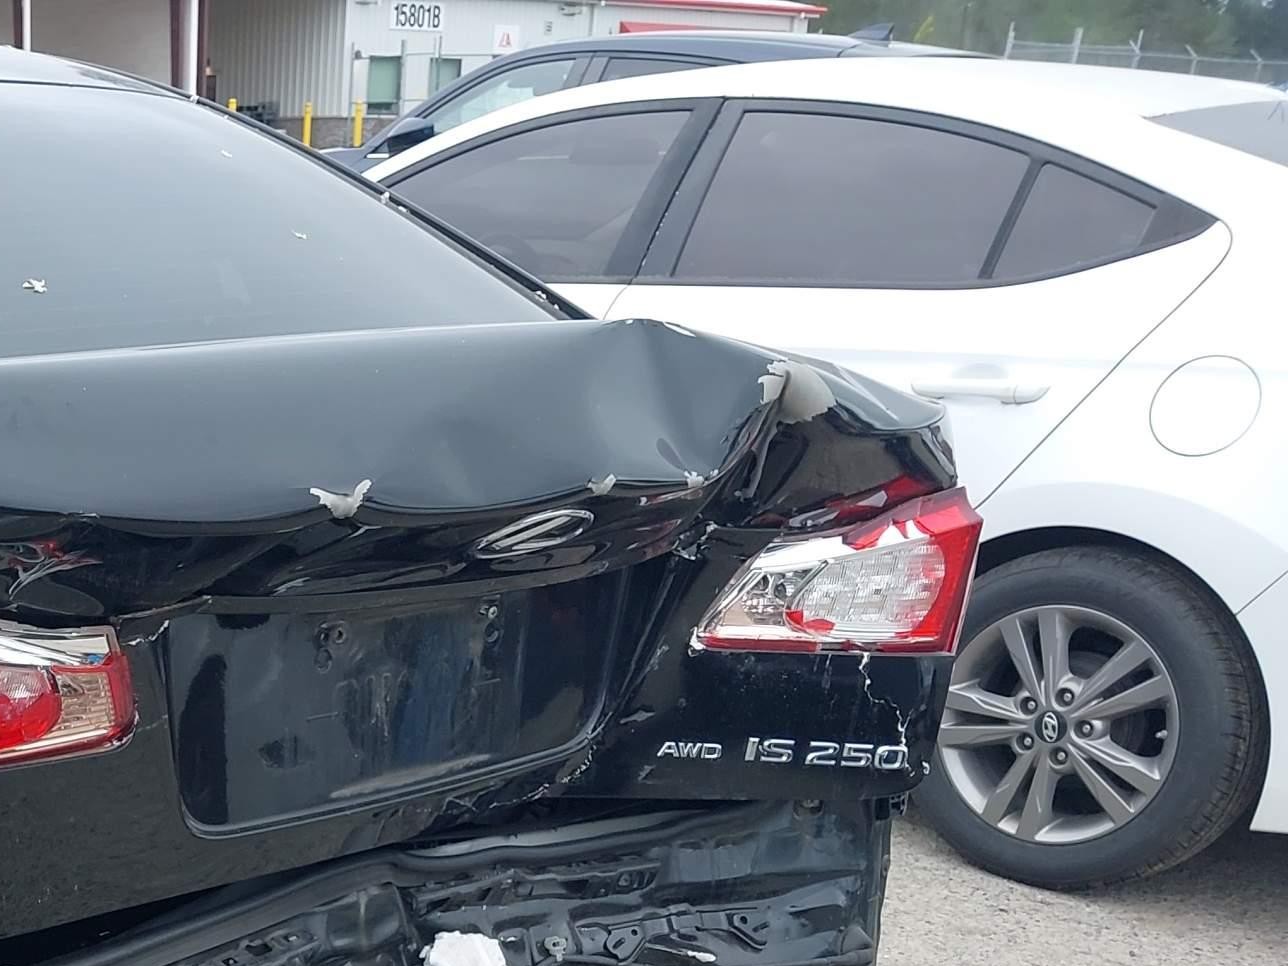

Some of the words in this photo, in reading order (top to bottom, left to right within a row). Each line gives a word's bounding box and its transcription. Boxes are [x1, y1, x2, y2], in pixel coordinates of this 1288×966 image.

[394, 3, 441, 28] 15801B
[657, 741, 722, 760] AWD
[744, 736, 796, 763] IS
[804, 741, 908, 771] 250
